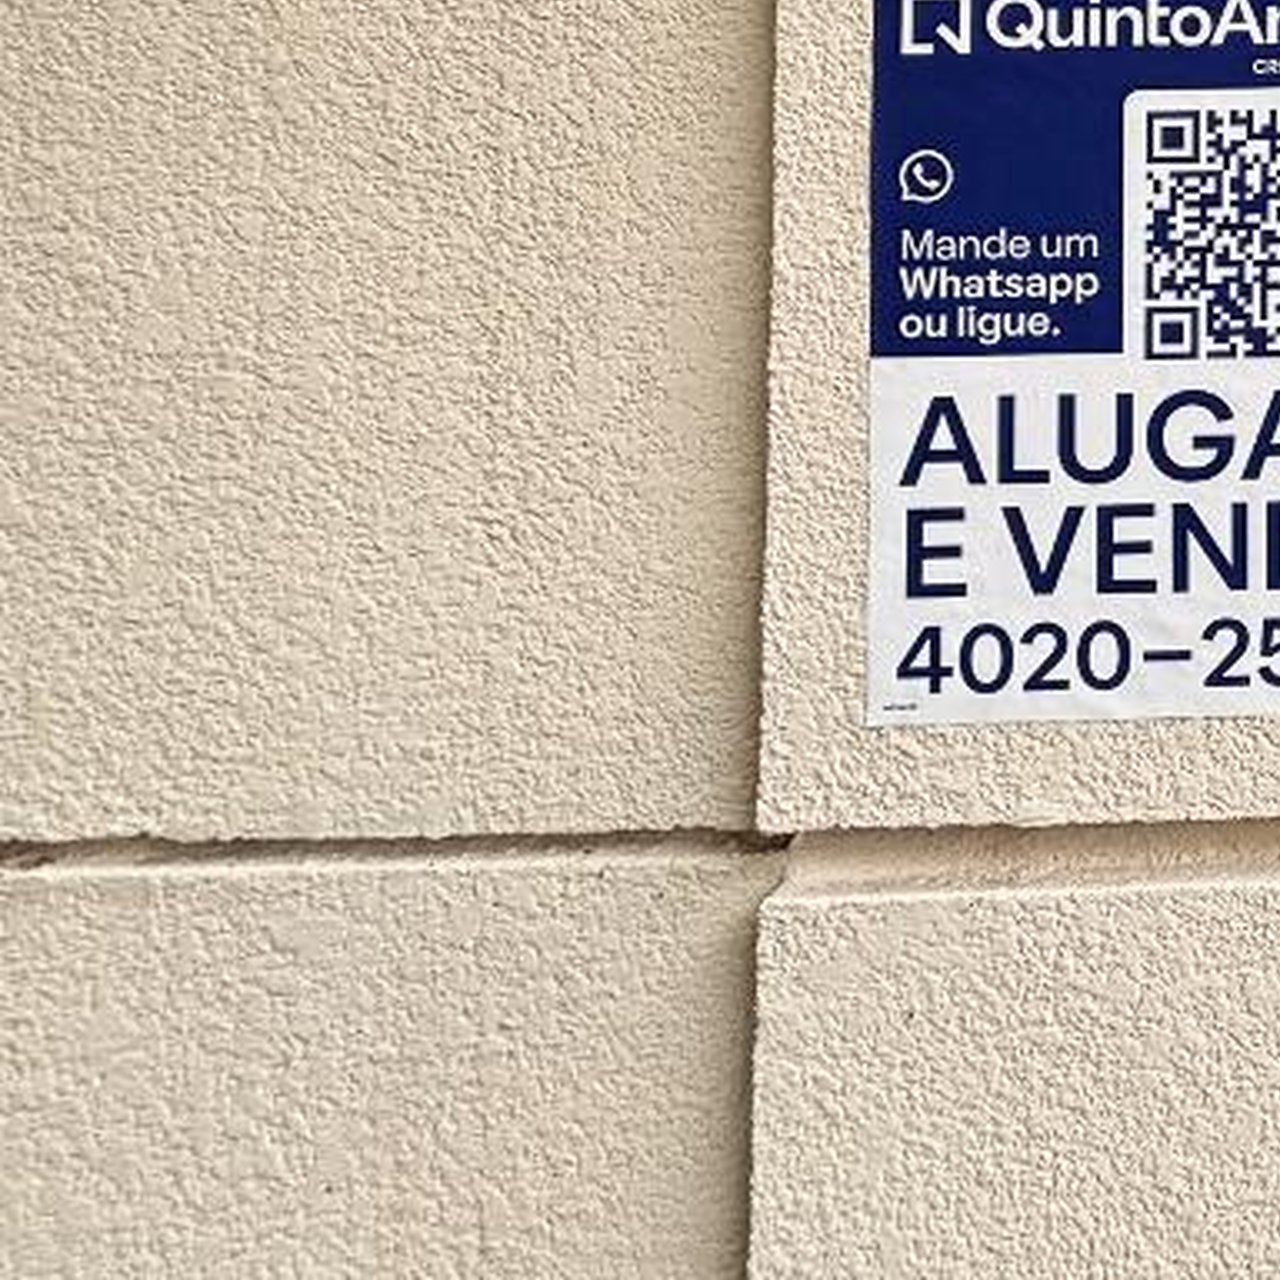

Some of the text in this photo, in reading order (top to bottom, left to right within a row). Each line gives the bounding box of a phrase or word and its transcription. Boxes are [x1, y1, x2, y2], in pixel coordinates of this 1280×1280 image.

[901, 228, 1098, 260] Mande um
[899, 269, 1099, 301] Whatsapp
[899, 306, 1061, 342] ou ligue.
[906, 508, 967, 598] E
